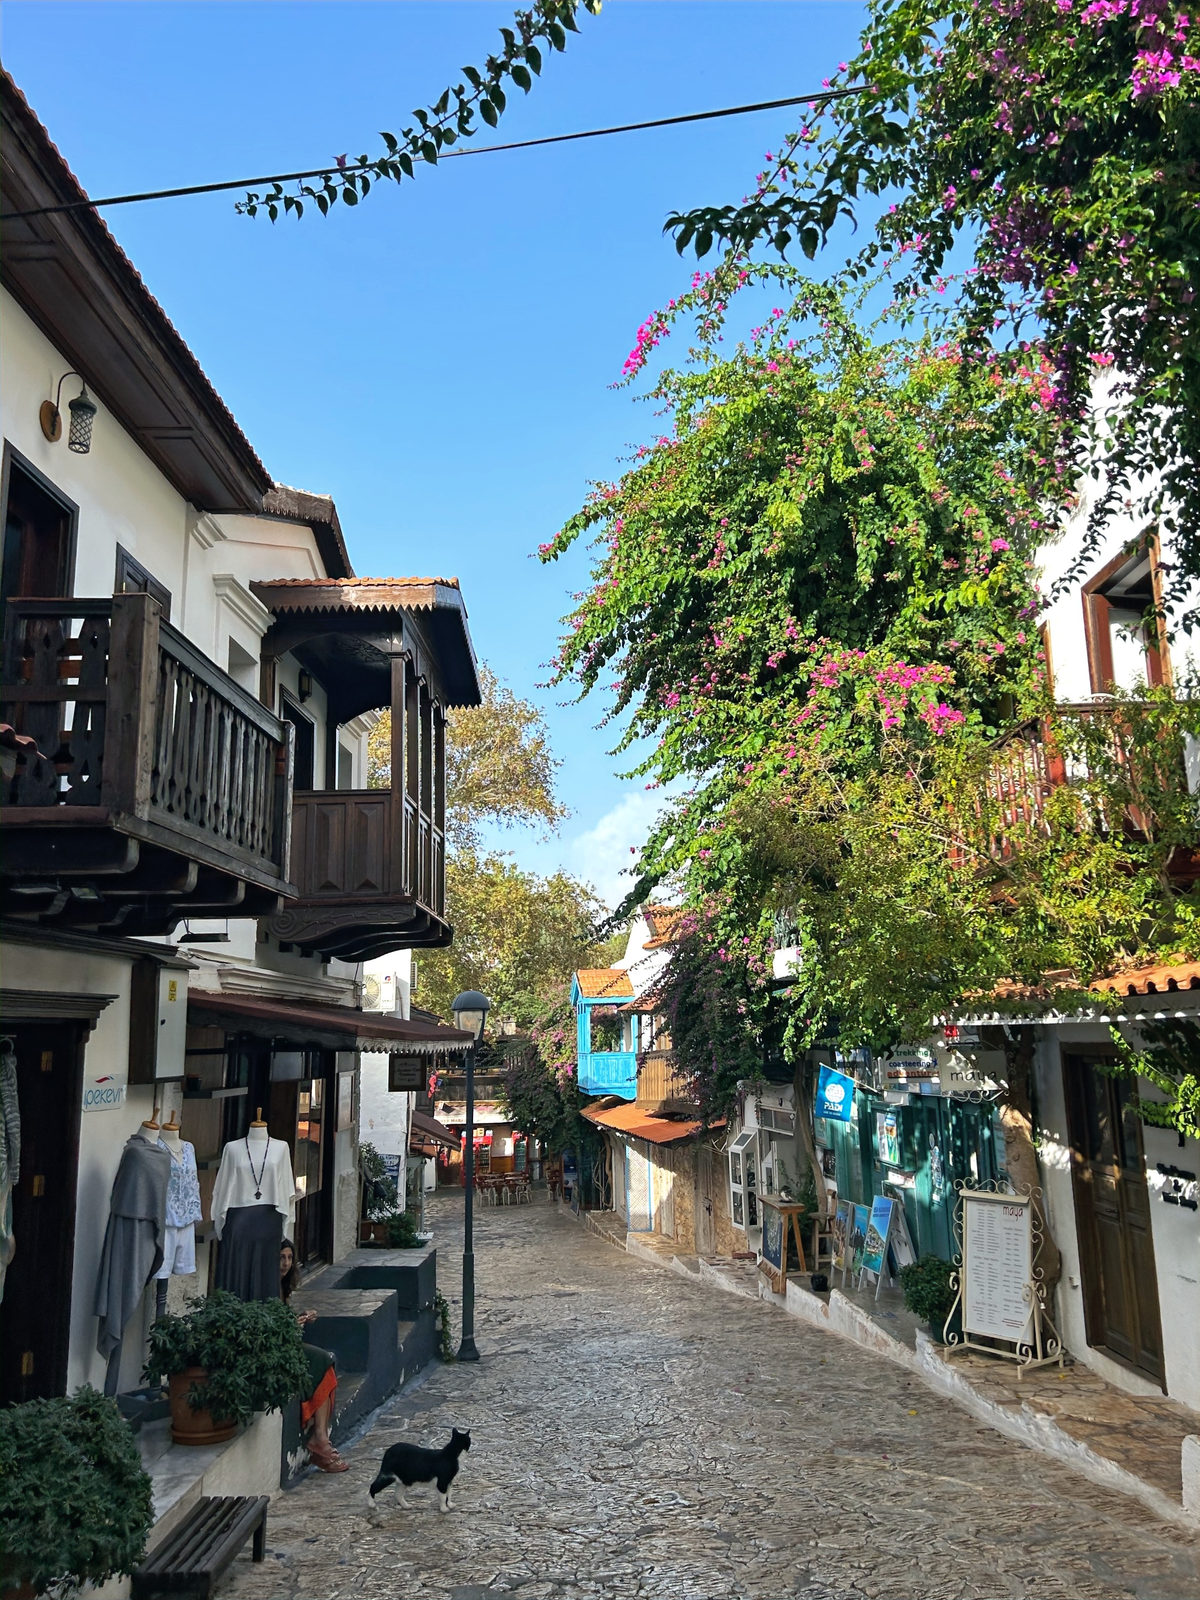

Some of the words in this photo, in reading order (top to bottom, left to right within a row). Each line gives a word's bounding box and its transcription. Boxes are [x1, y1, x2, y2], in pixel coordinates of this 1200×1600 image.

[896, 1049, 929, 1058] trekking
[888, 1060, 931, 1069] coasteering
[951, 1070, 996, 1086] maya
[824, 1102, 843, 1112] PADI
[1002, 1206, 1023, 1221] maya
